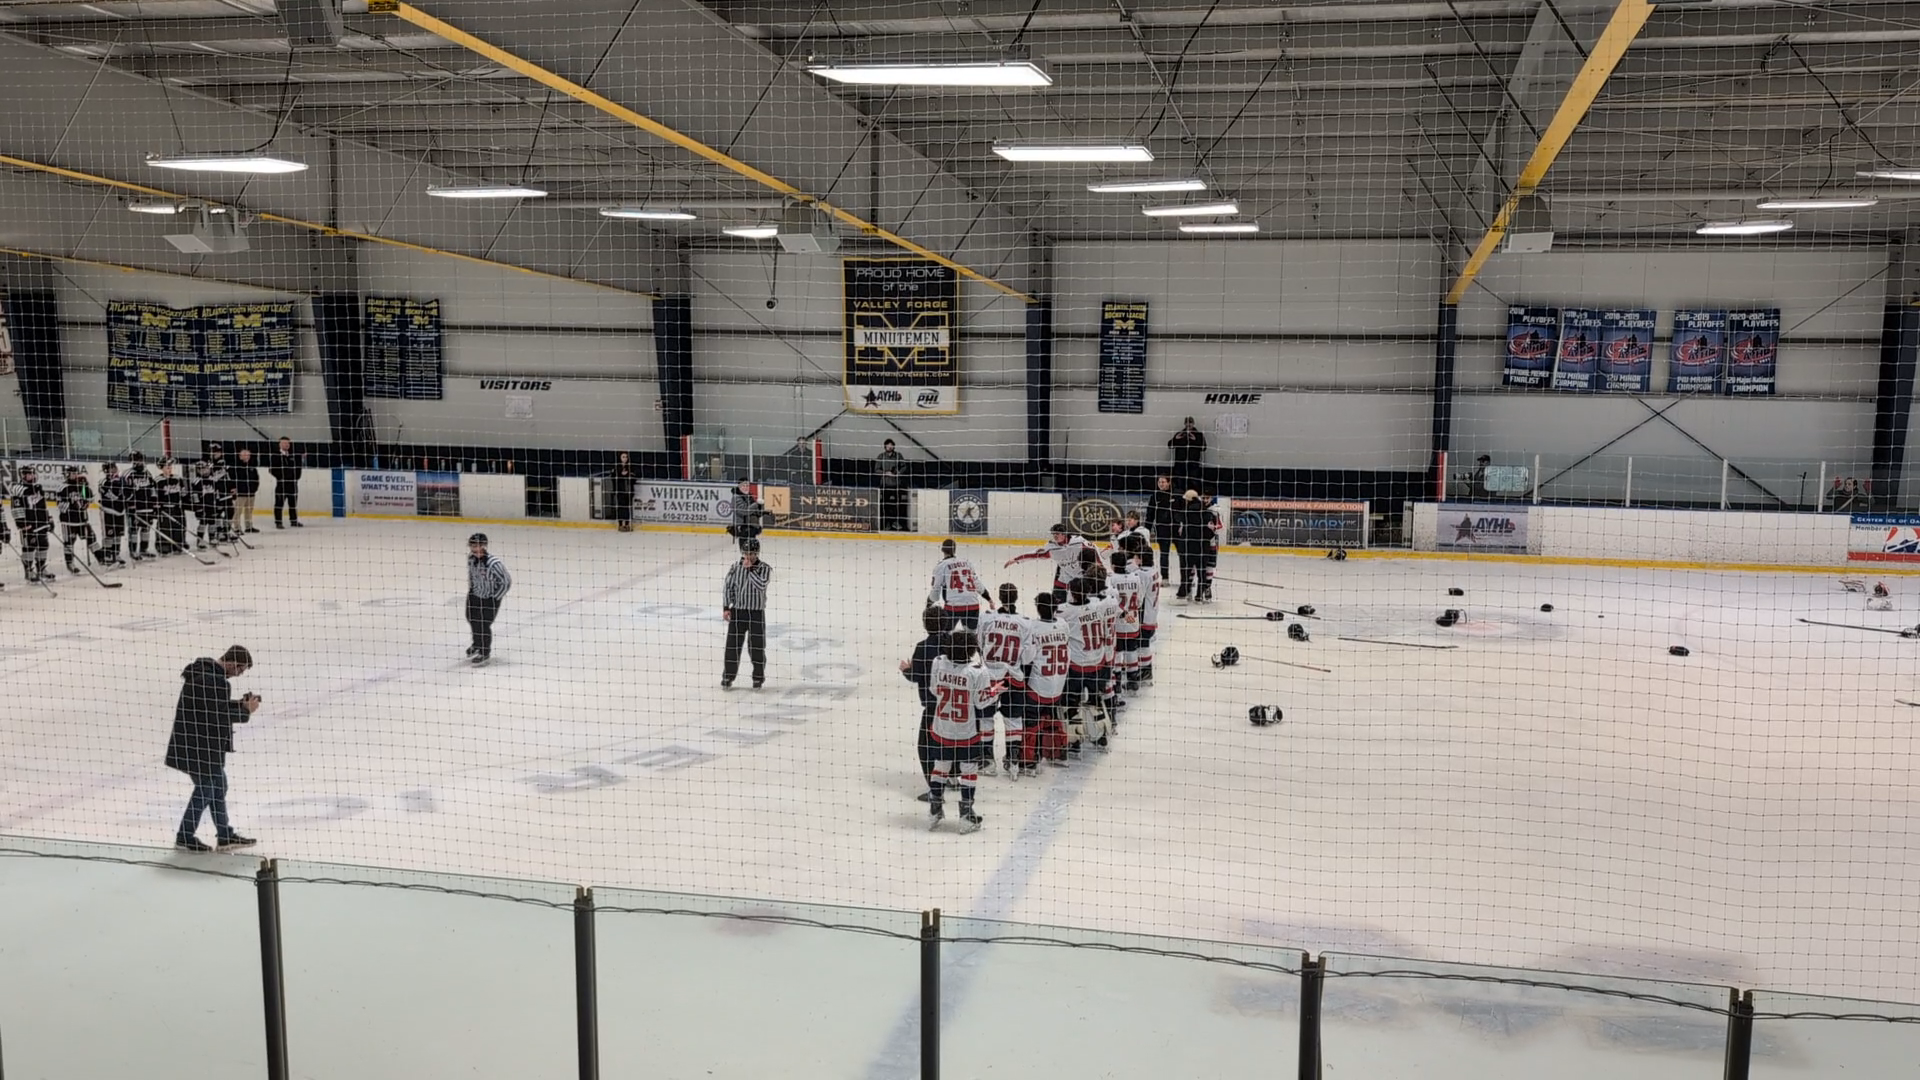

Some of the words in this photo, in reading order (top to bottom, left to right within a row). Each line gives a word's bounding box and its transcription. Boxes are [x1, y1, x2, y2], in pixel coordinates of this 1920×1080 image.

[856, 269, 902, 278] PROUD
[906, 268, 945, 278] HOME
[882, 283, 894, 291] of
[899, 282, 919, 291] the
[853, 301, 900, 309] VALLEY
[907, 301, 949, 309] FORGE
[1523, 316, 1556, 325] PLAYOFFS
[1604, 312, 1640, 320] 2018-2019
[1619, 320, 1654, 328] PLAYOFFS
[1688, 320, 1725, 328] PLAYOFFS
[864, 331, 940, 345] MINUTEMEN
[1510, 376, 1540, 384] FINALIST
[1555, 380, 1588, 388] CHAMPION
[480, 380, 552, 391] VISITORS
[1204, 393, 1262, 404] HOME
[361, 475, 383, 483] GAME
[390, 484, 414, 492] NEXT?
[650, 487, 719, 501] WHITPAIN
[772, 494, 782, 507] N
[800, 495, 869, 507] NEILD
[663, 501, 709, 512] TAVERN
[1314, 502, 1363, 511] FABRICATION
[662, 513, 707, 521] 610-272-2525
[950, 569, 976, 593] 43
[1116, 582, 1137, 591] BUTLER
[994, 620, 1018, 632] TAYLOR
[986, 632, 1020, 667] 20
[1041, 645, 1069, 676] 39
[938, 673, 968, 687] LASHER
[937, 685, 970, 723] 29
